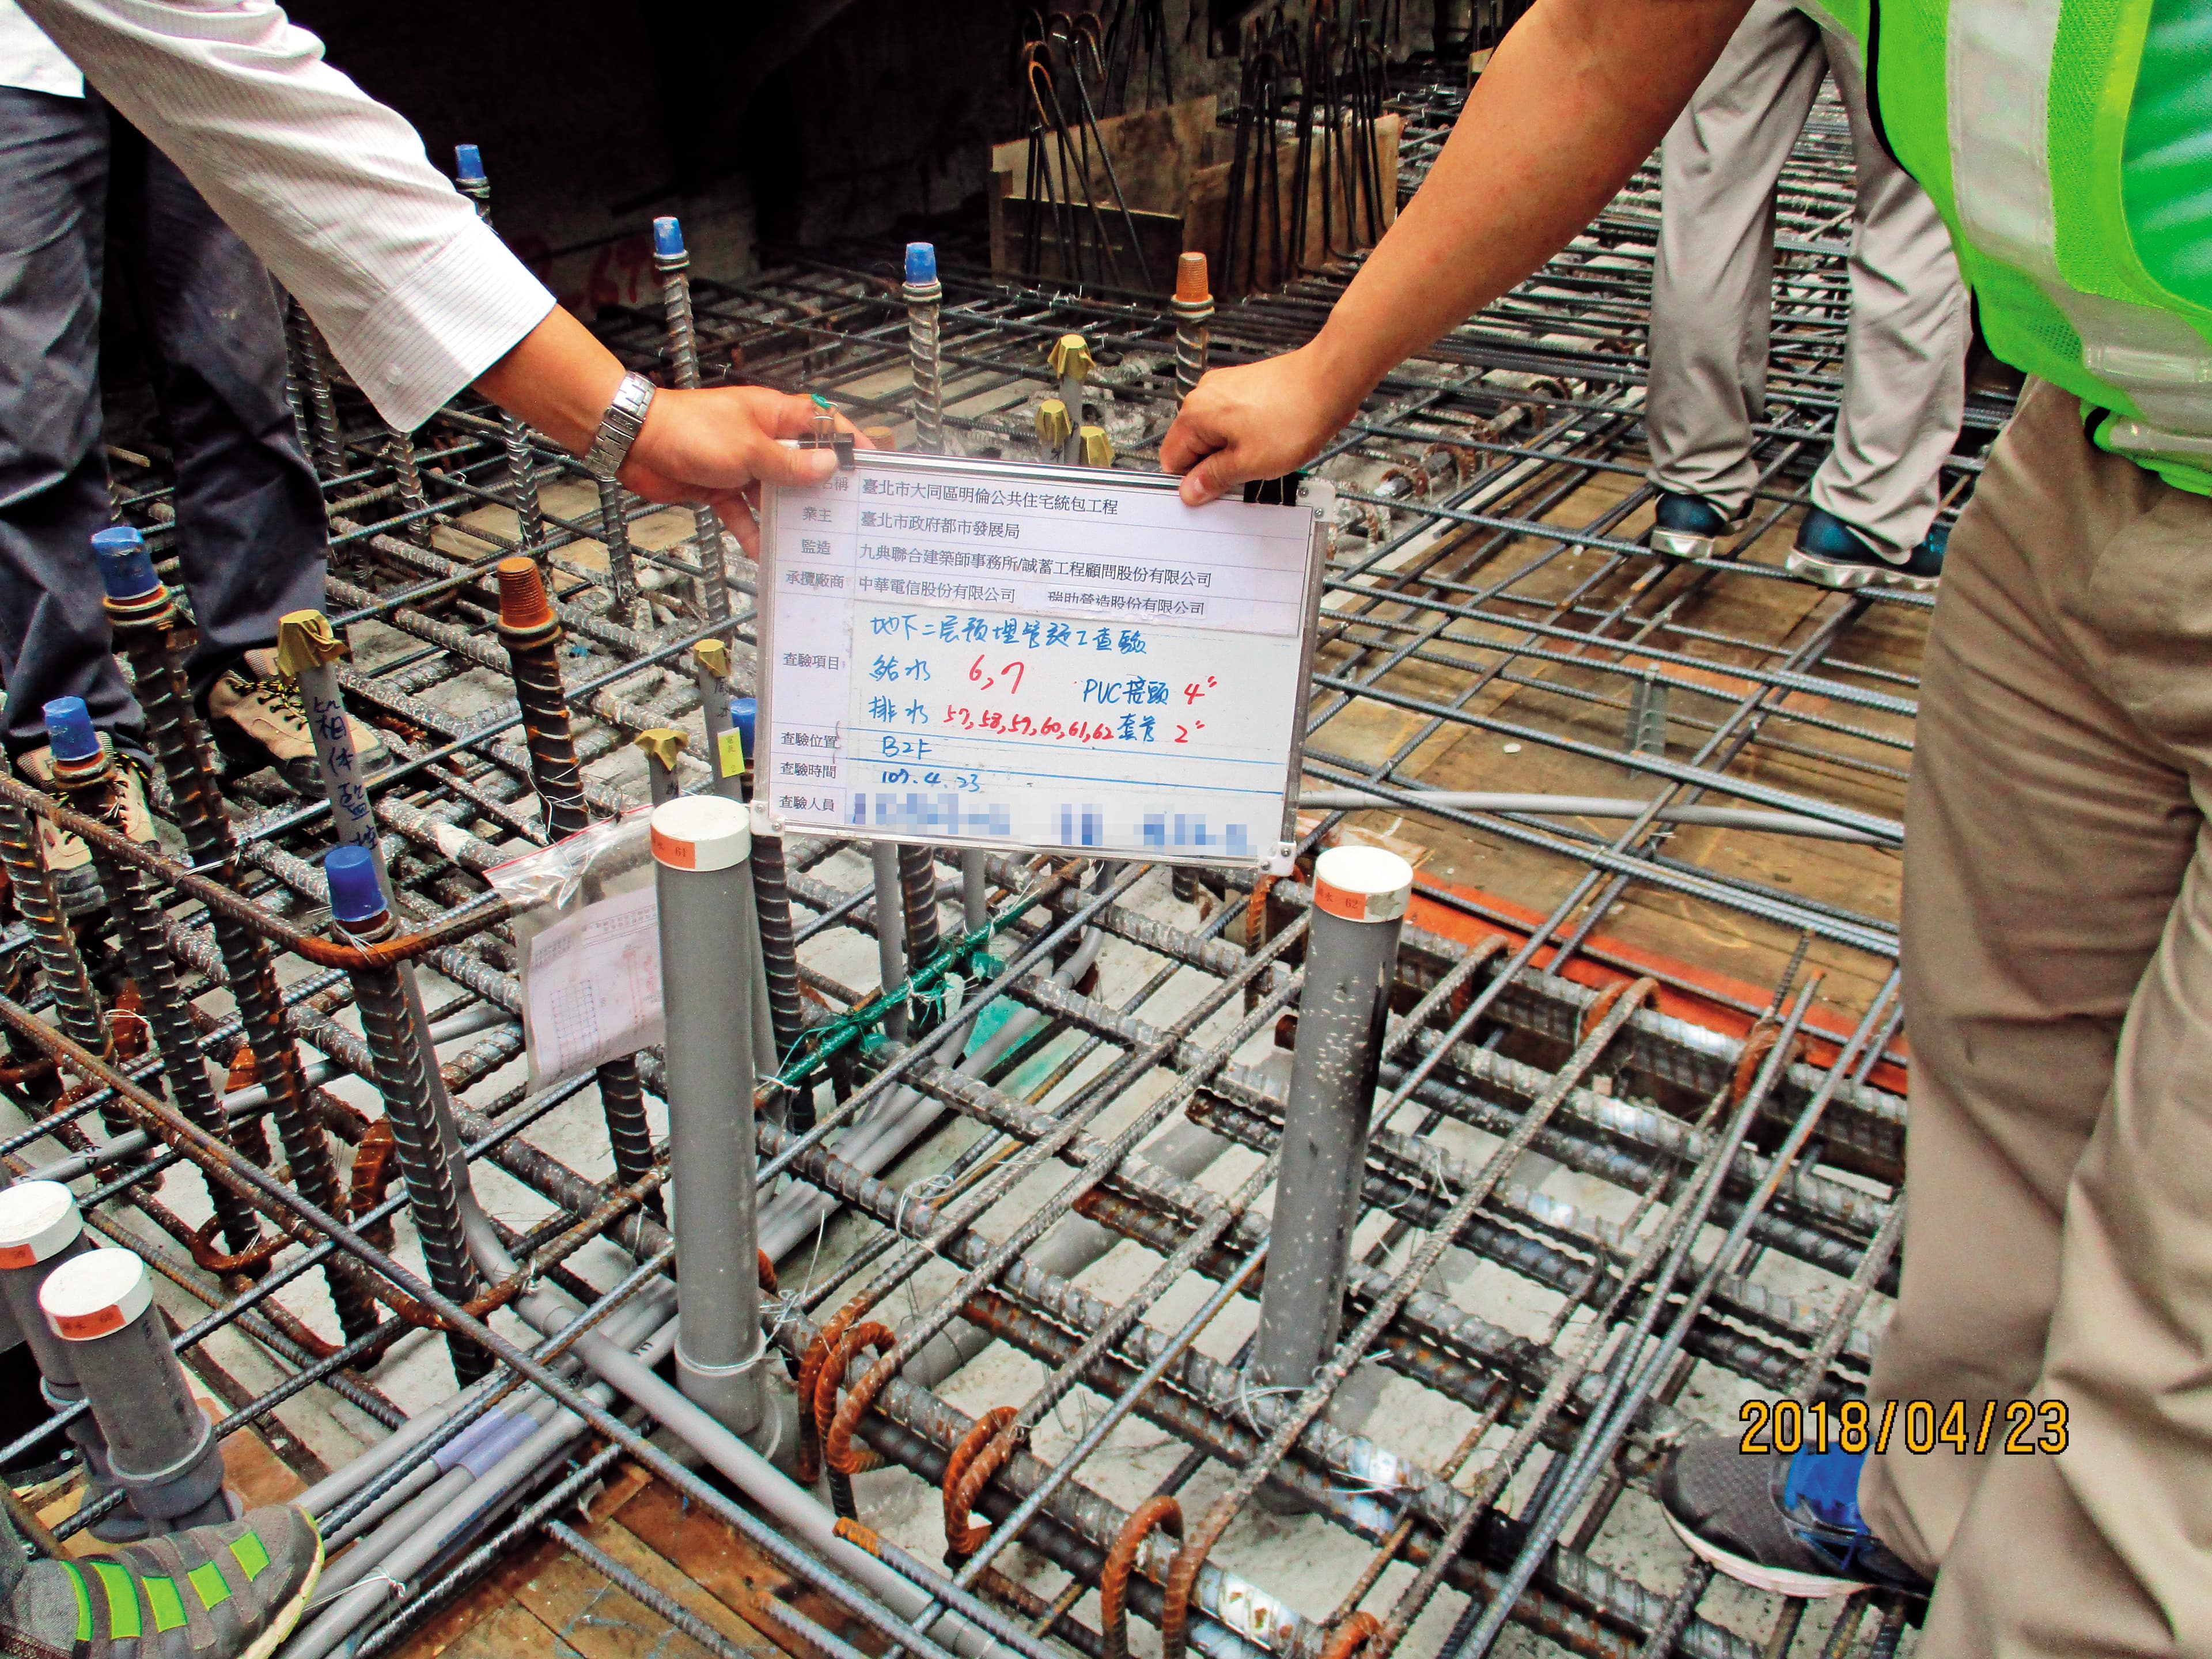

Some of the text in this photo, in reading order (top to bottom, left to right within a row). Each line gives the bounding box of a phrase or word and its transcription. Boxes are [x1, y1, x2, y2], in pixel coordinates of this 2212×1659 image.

[862, 478, 1119, 516] 臺北市大同區明倫公共住宅統包工程
[802, 506, 1020, 540] 業主 臺北市政府都市發展局
[801, 539, 831, 555] 監造
[785, 570, 844, 589] 承攬廠商
[859, 576, 1016, 604] 中華電信股份有限公司
[783, 652, 840, 670] 查驗項目
[868, 695, 929, 725] 排水
[781, 731, 838, 749] 查驗位置
[882, 735, 932, 760] B2F
[781, 761, 836, 779] 查驗時間
[779, 795, 835, 812] 查驗人員
